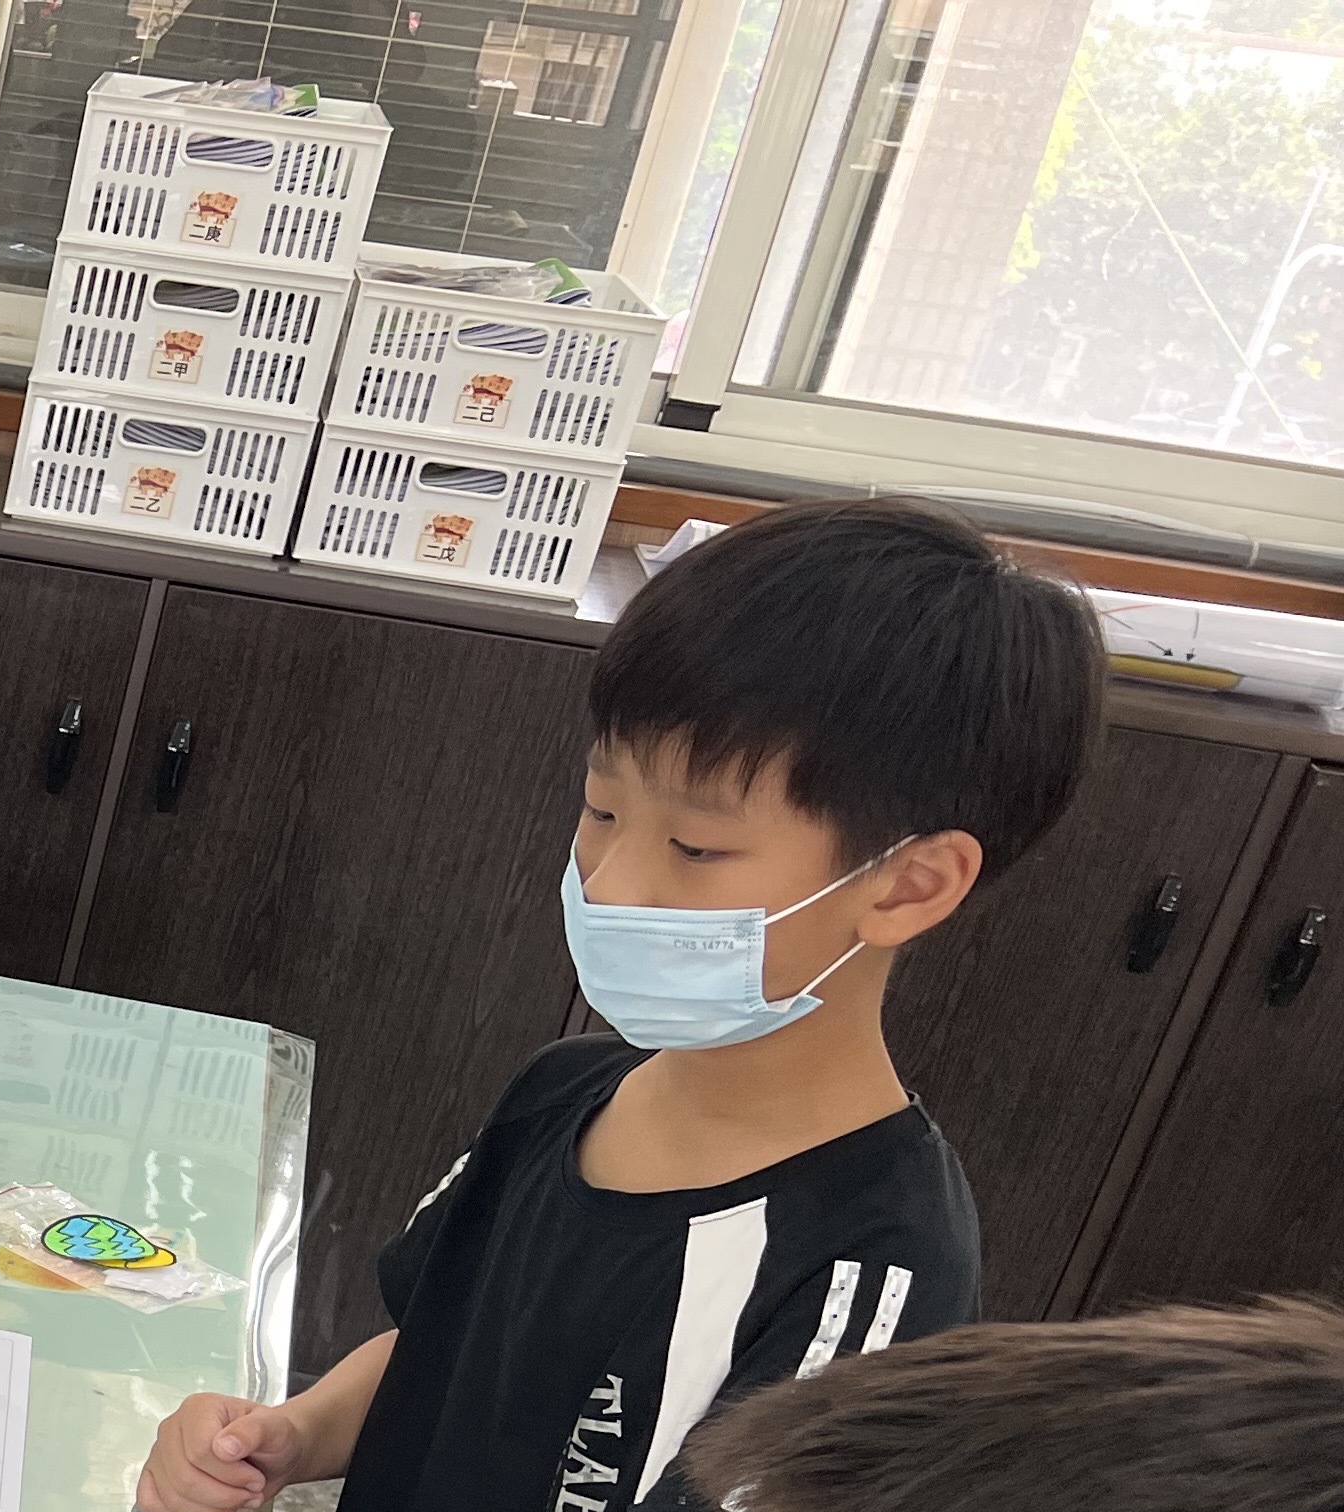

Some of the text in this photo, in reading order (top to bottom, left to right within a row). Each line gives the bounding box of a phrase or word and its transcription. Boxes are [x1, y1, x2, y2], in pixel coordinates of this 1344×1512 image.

[189, 224, 222, 242] 二庚
[156, 361, 188, 378] 二甲
[129, 496, 160, 513] 二乙
[673, 939, 734, 951] CNS 14774
